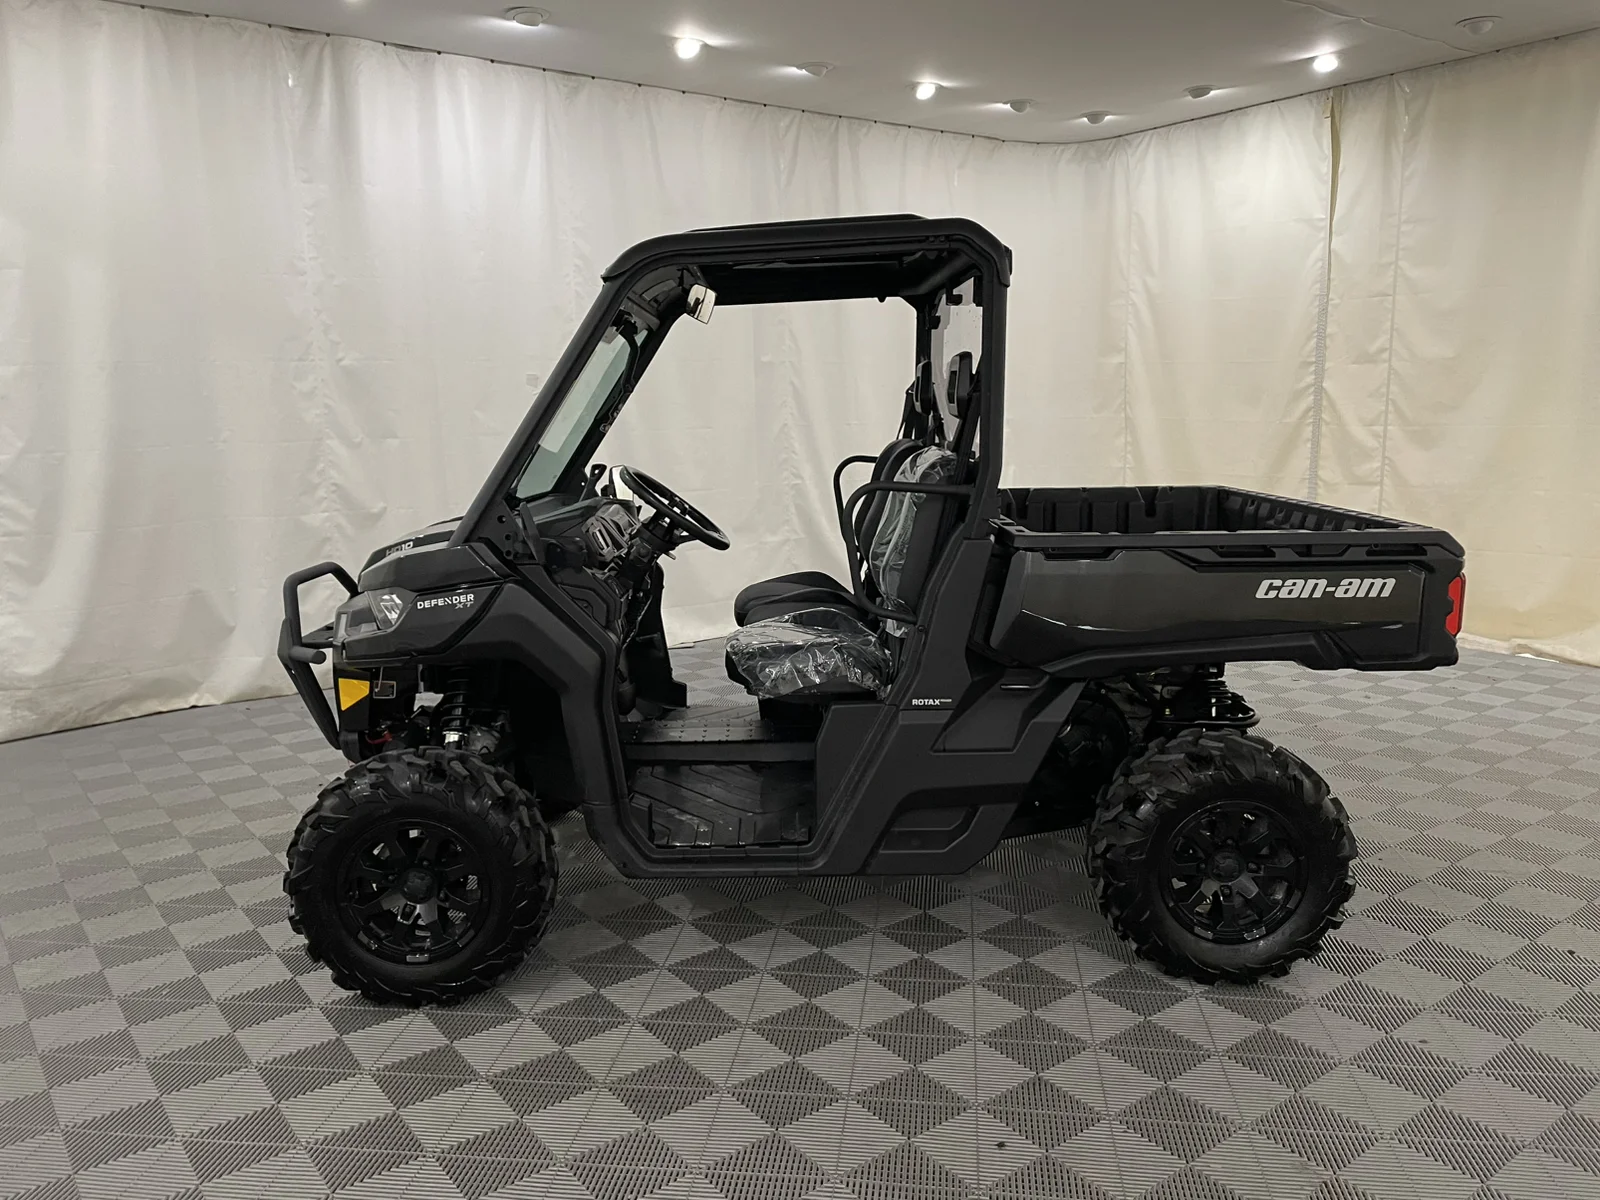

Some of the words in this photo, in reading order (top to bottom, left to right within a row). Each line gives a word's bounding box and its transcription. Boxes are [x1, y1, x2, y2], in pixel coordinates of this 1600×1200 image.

[1255, 577, 1397, 599] can-am
[417, 593, 475, 609] DEFENDER
[911, 698, 940, 706] ROTAX
